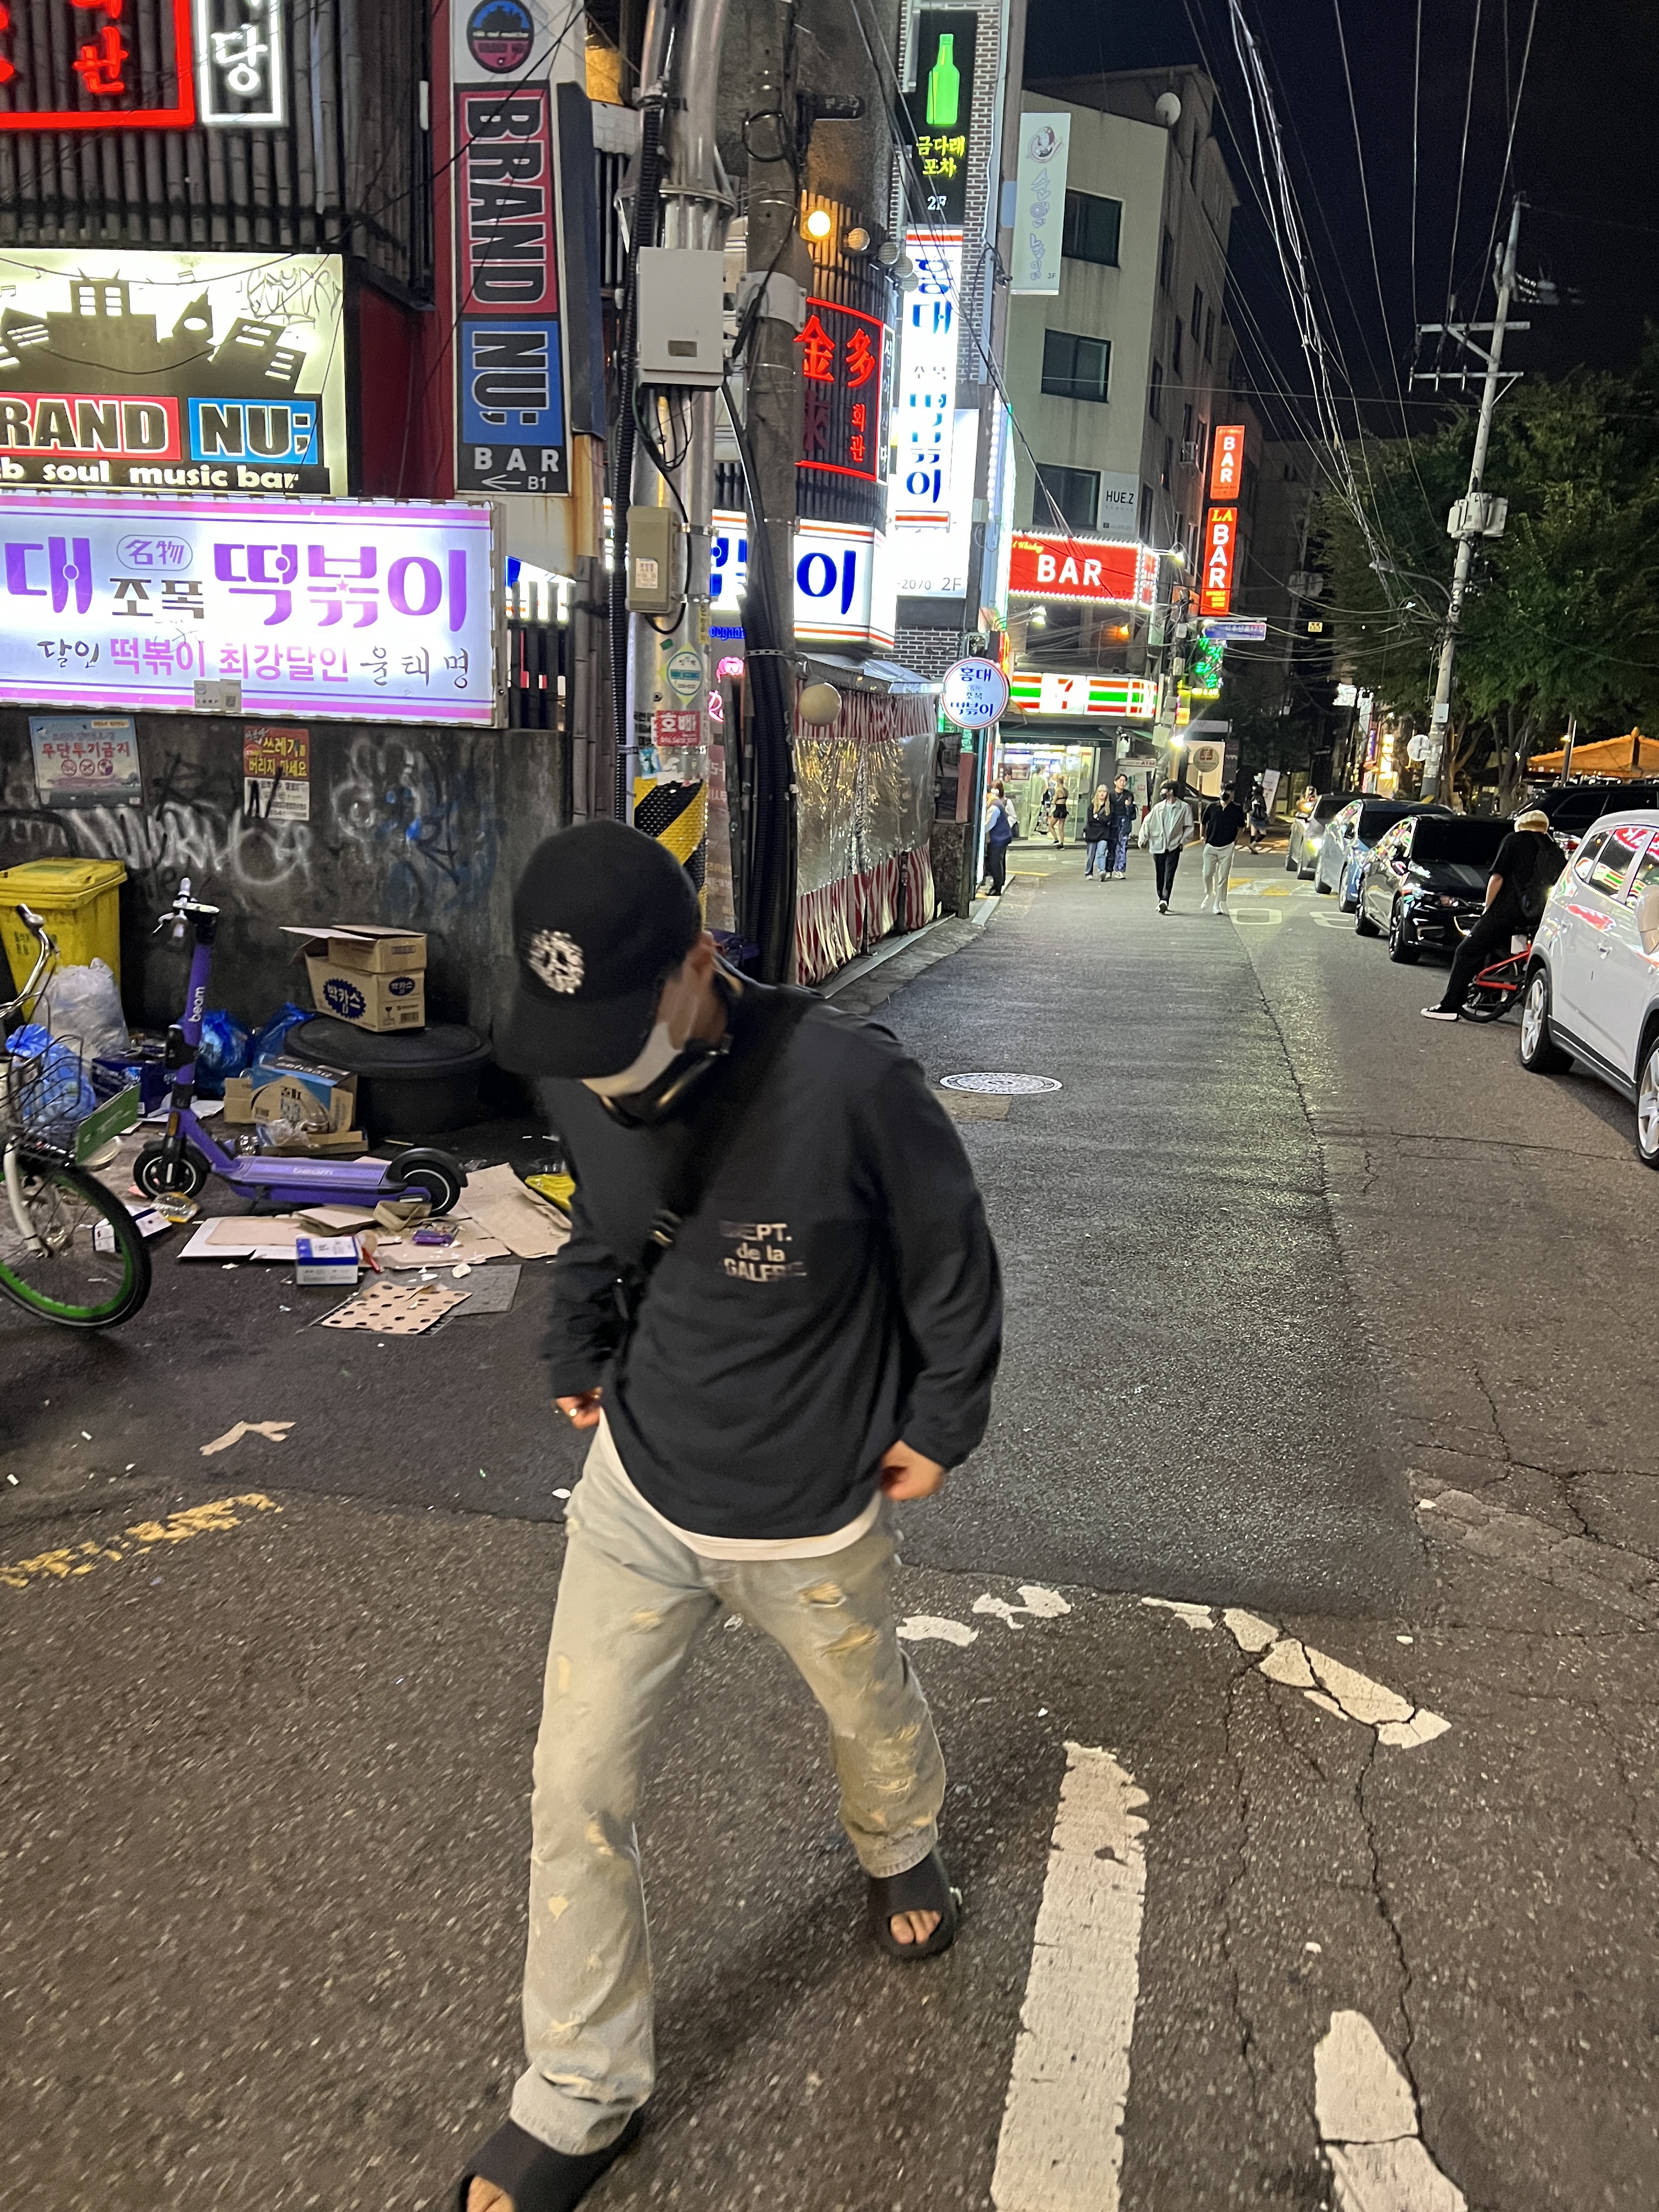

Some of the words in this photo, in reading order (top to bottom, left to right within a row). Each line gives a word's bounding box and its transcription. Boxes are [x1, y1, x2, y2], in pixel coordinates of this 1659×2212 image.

[916, 135, 966, 157] 금다래
[922, 157, 957, 178] 포차
[466, 97, 547, 304] BRAND
[475, 447, 559, 472] BAR
[1220, 436, 1235, 483] BAR
[43, 460, 111, 483] soul
[129, 464, 229, 487] music
[237, 464, 300, 489] bar
[528, 476, 546, 490] B1
[1211, 509, 1233, 521] LA
[125, 539, 184, 566] 名物
[1209, 523, 1229, 589] BAR
[1037, 554, 1102, 586] BAR
[214, 543, 467, 632] 떡볶이
[941, 577, 962, 591] 2F
[110, 578, 204, 619] 조폭
[37, 638, 99, 668] 달인
[110, 637, 205, 677] 떡볶이
[219, 642, 348, 682] 최강달인
[960, 665, 992, 682] 홍대
[42, 741, 130, 760] 무단투기금지
[188, 986, 206, 1022] beam
[293, 1166, 334, 1176] beam
[736, 1242, 761, 1261] de
[766, 1244, 786, 1262] la
